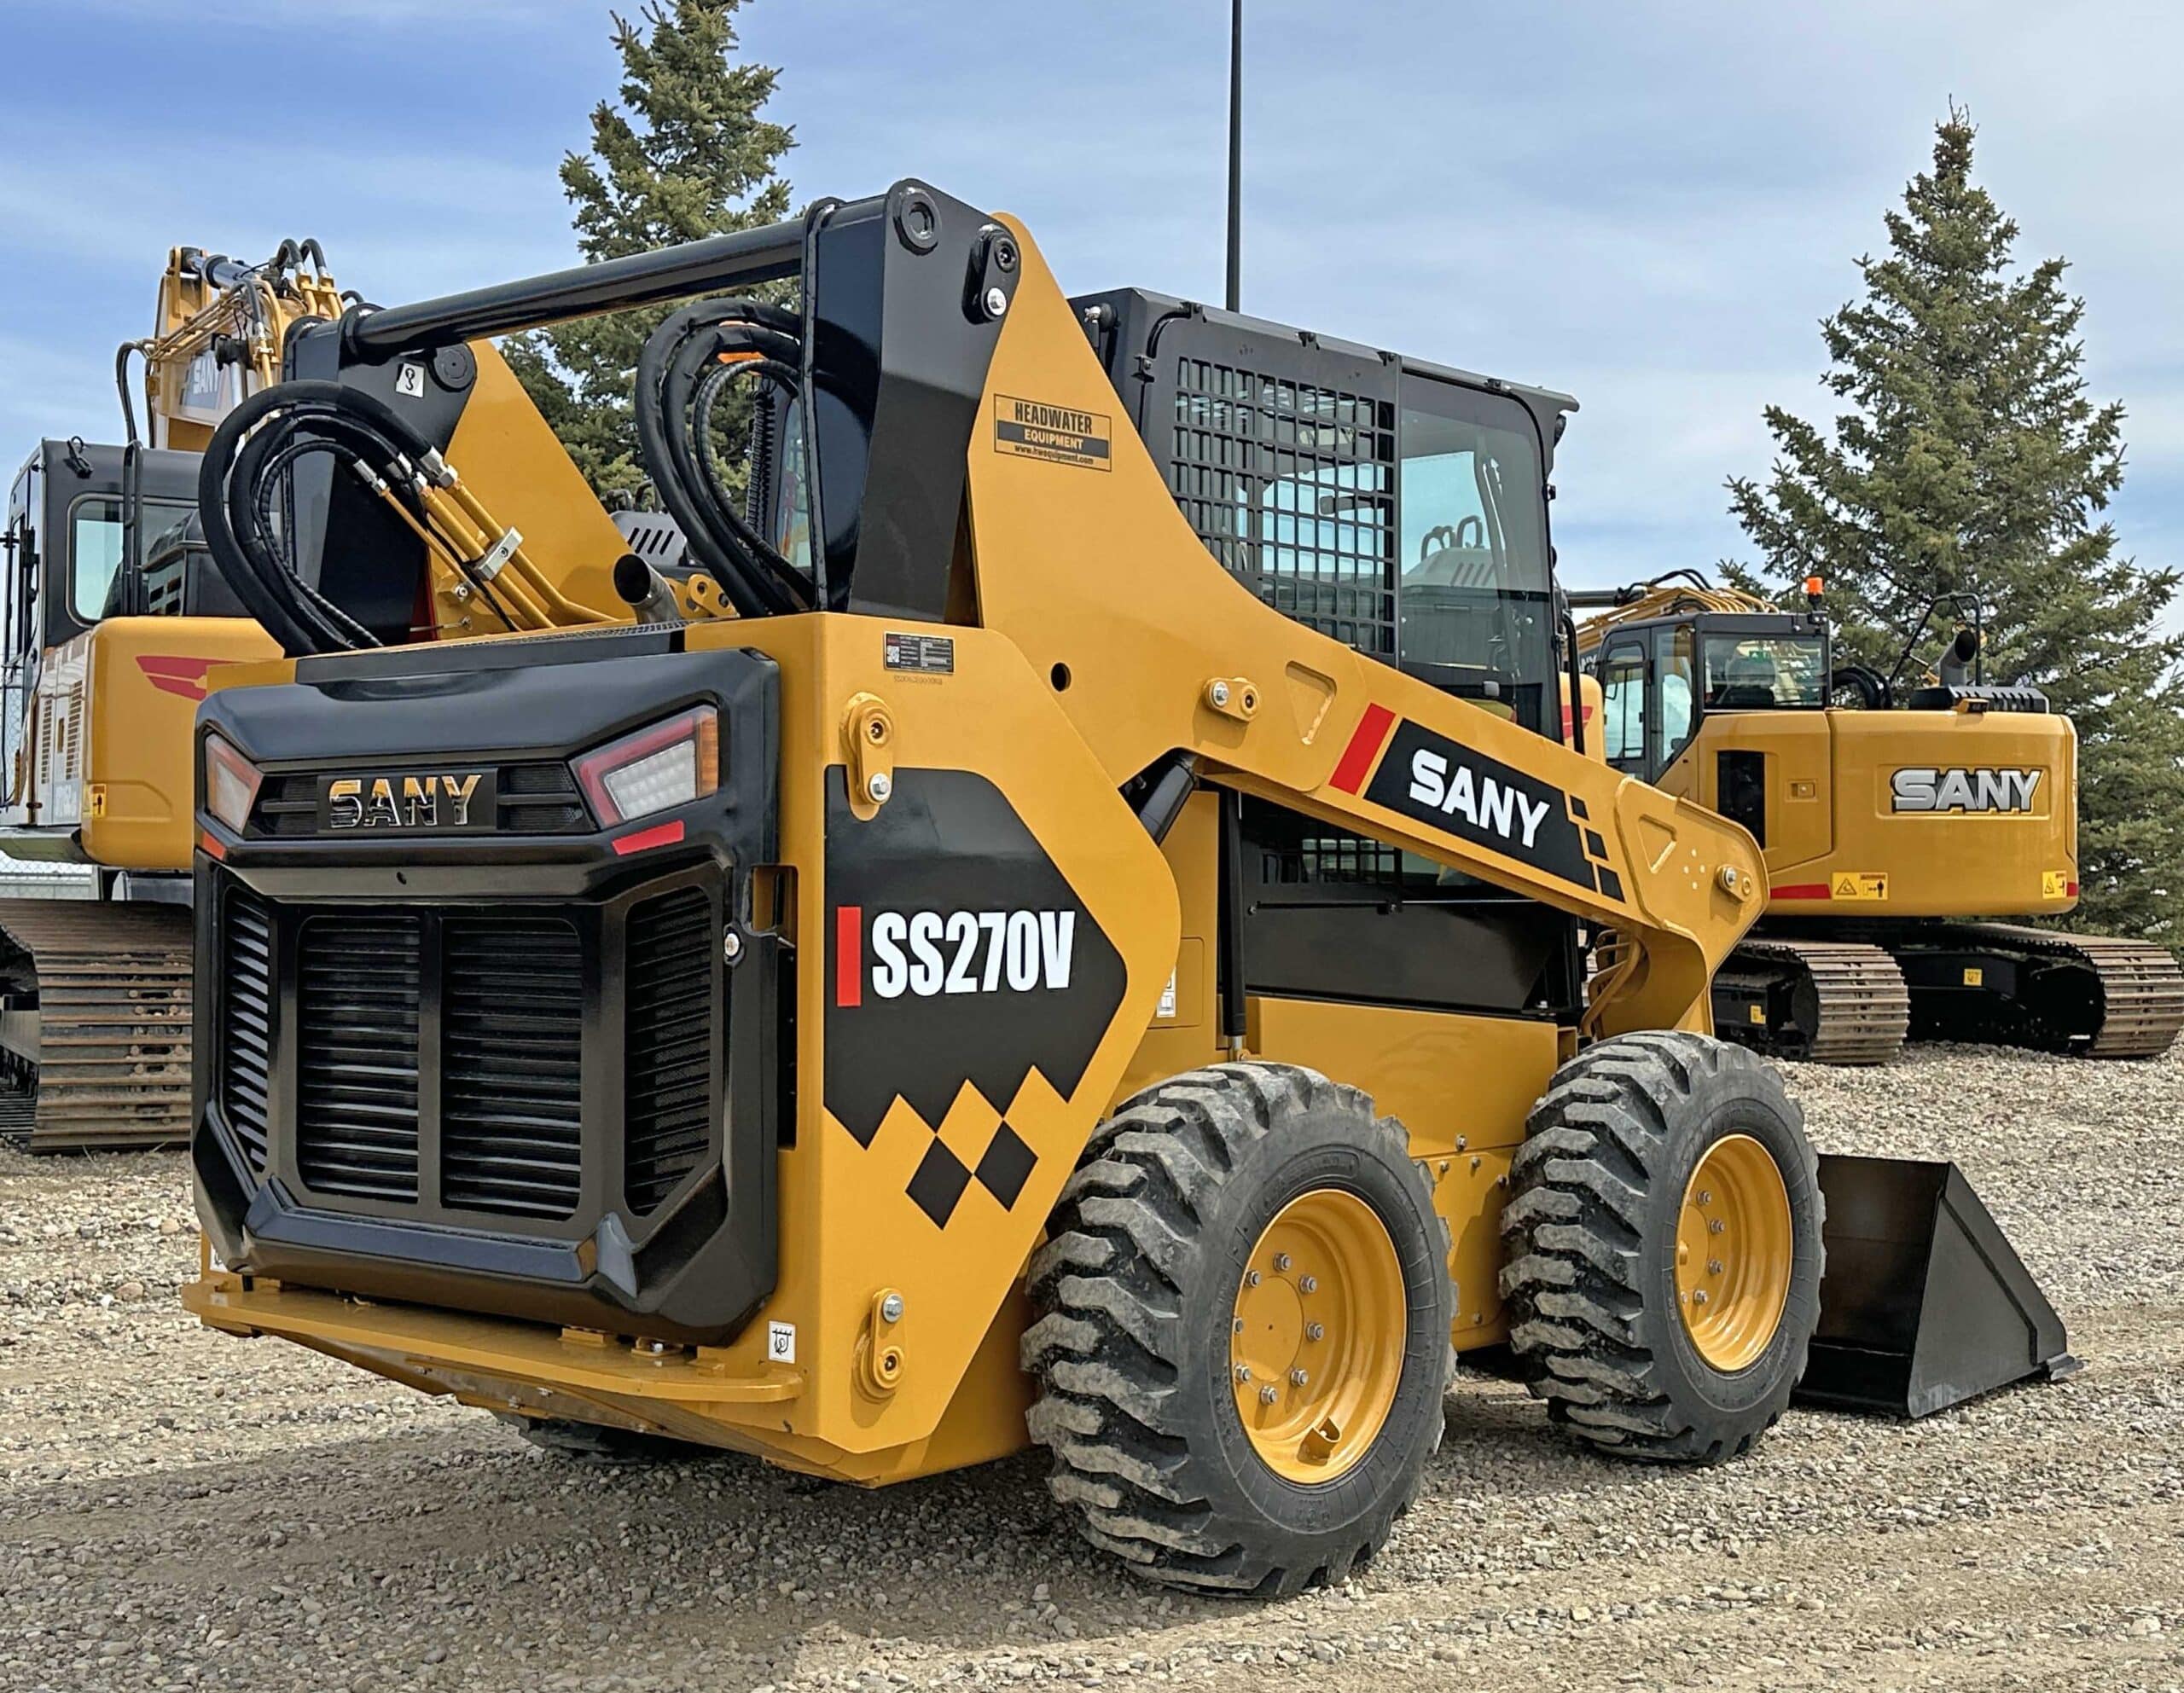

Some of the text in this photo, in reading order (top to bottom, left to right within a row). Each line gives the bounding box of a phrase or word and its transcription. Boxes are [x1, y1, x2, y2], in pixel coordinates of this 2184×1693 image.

[1014, 402, 1092, 435] HEADWATER
[1025, 428, 1083, 450] EQUIPMENT
[329, 774, 482, 828] SANY
[1409, 748, 1550, 849] SANY
[1891, 768, 2043, 812] SANY
[872, 910, 1076, 999] SS270V
